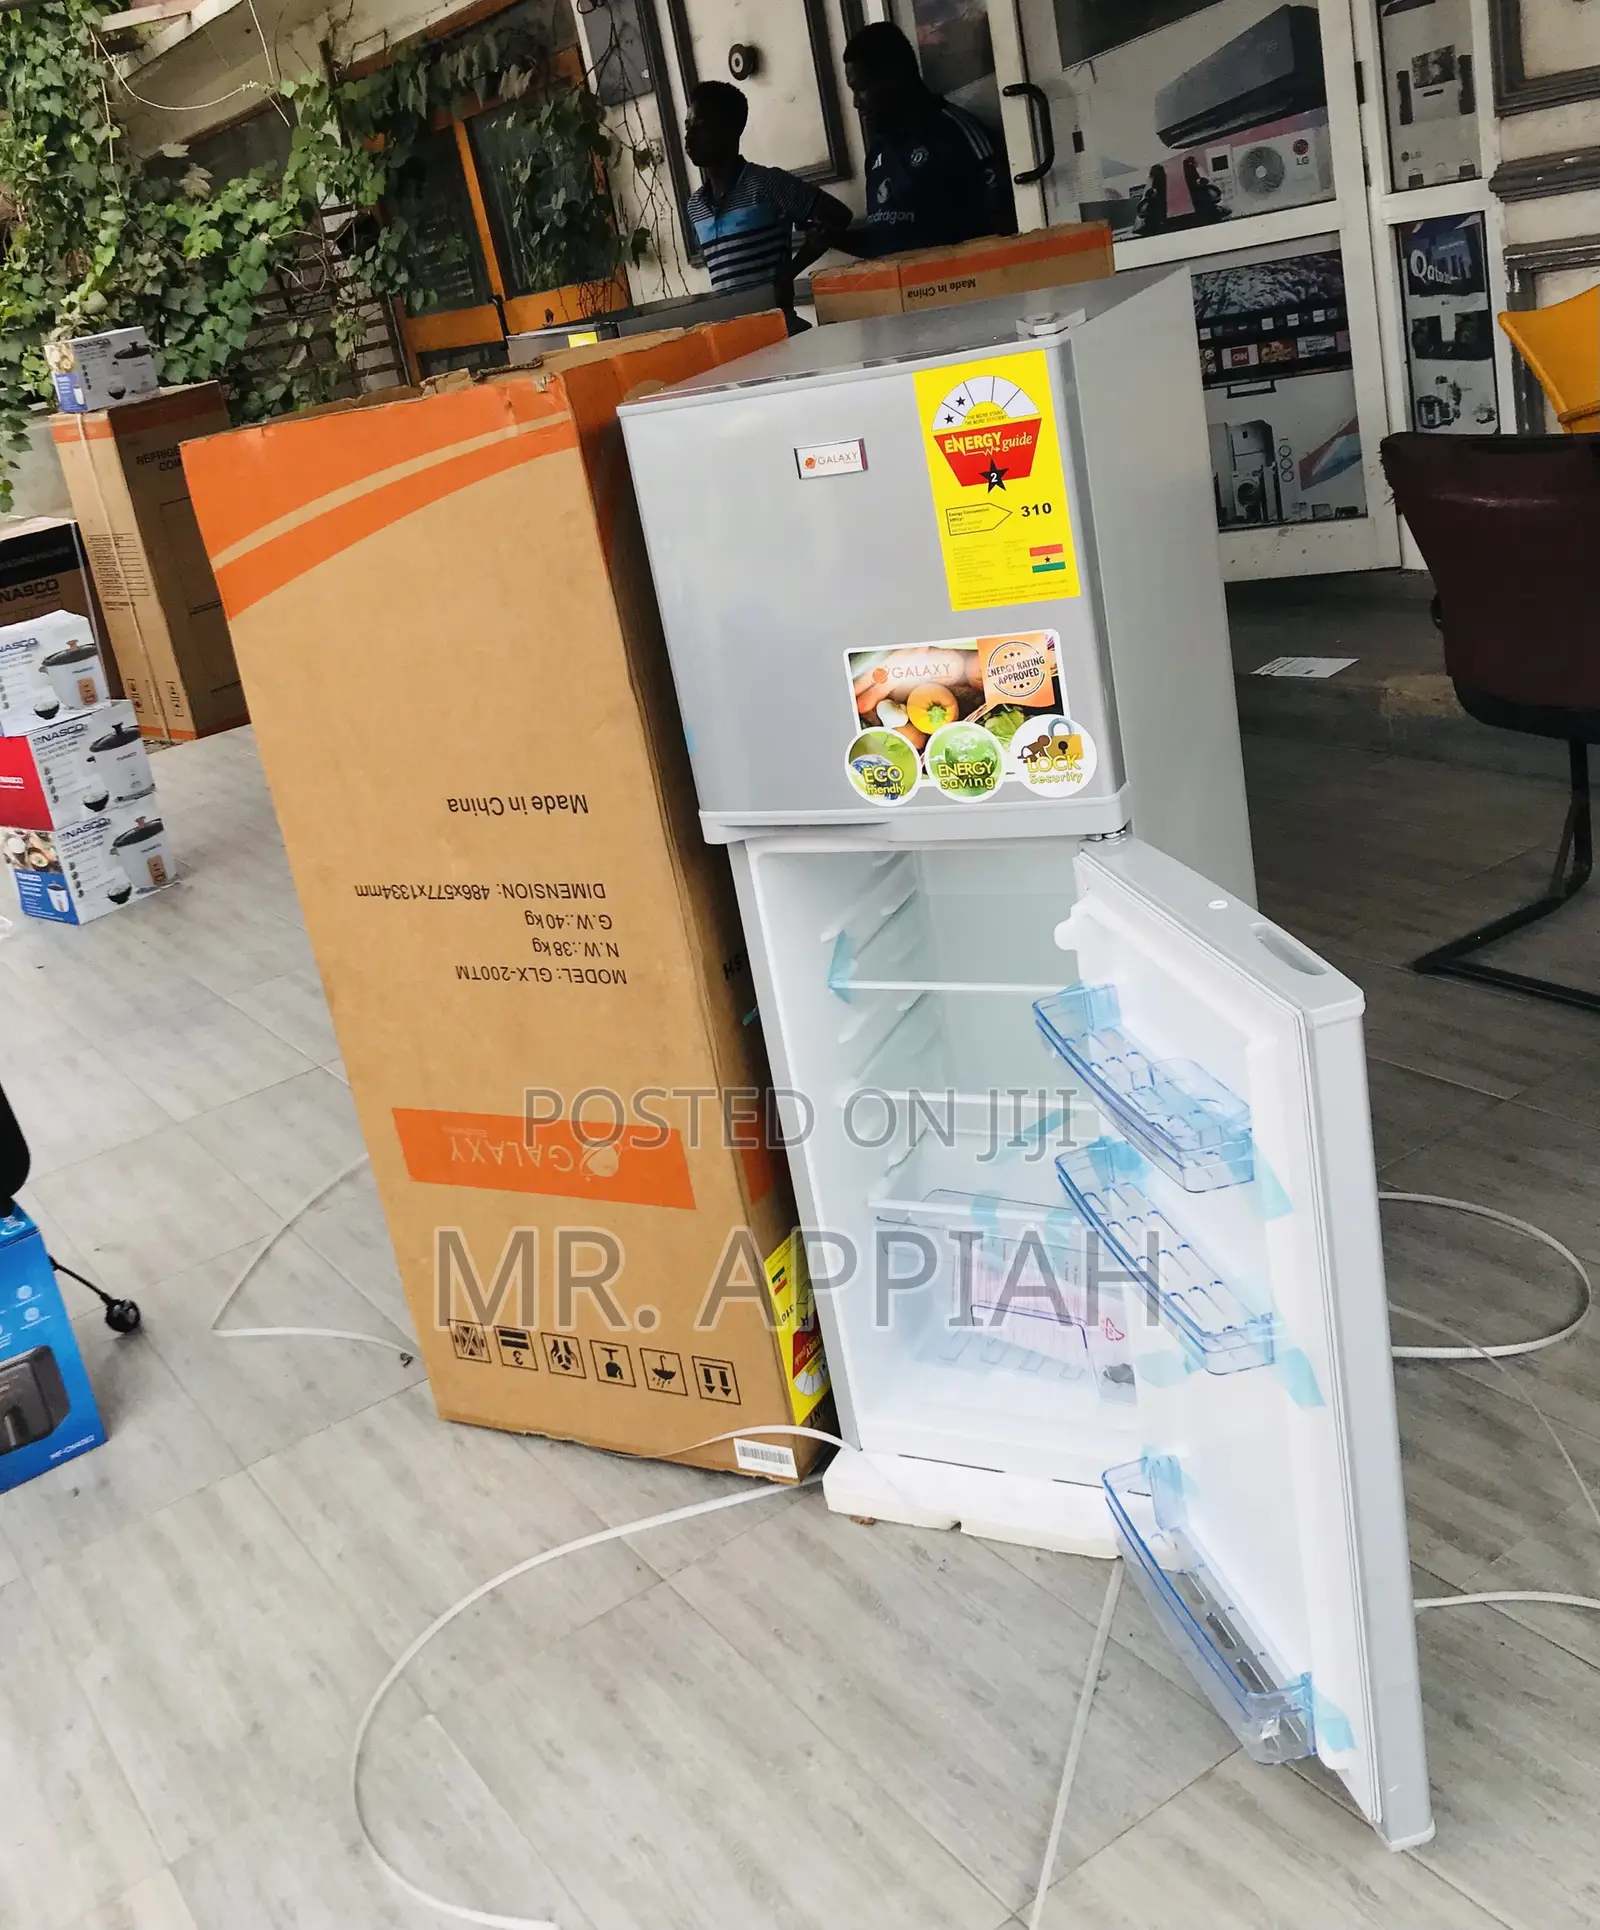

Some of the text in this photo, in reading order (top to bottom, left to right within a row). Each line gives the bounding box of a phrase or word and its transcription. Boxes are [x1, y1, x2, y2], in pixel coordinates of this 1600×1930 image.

[1296, 156, 1310, 166] LG
[907, 286, 937, 299] China
[950, 278, 976, 292] Made
[944, 431, 1033, 456] ENERGY guide
[818, 452, 858, 465] GALAXY
[990, 472, 998, 483] 2
[1020, 503, 1052, 517] 310
[891, 663, 952, 679] GALAXY
[987, 656, 1046, 678] ENERGY RATING
[998, 667, 1040, 686] APPROVED
[42, 722, 84, 741] NASCO
[937, 760, 994, 778] ENERGY
[1026, 753, 1082, 774] LOCK
[862, 765, 904, 783] ECO
[1029, 770, 1083, 785] Security
[865, 783, 905, 796] friendly
[941, 776, 996, 791] saving
[447, 793, 589, 817] Made in China
[67, 817, 110, 839] NASCO
[354, 882, 607, 901] DIMENSION: 486x577x1334mm
[455, 965, 628, 985] MODEL: GLX-200TM
[449, 1135, 575, 1172] GALAXY
